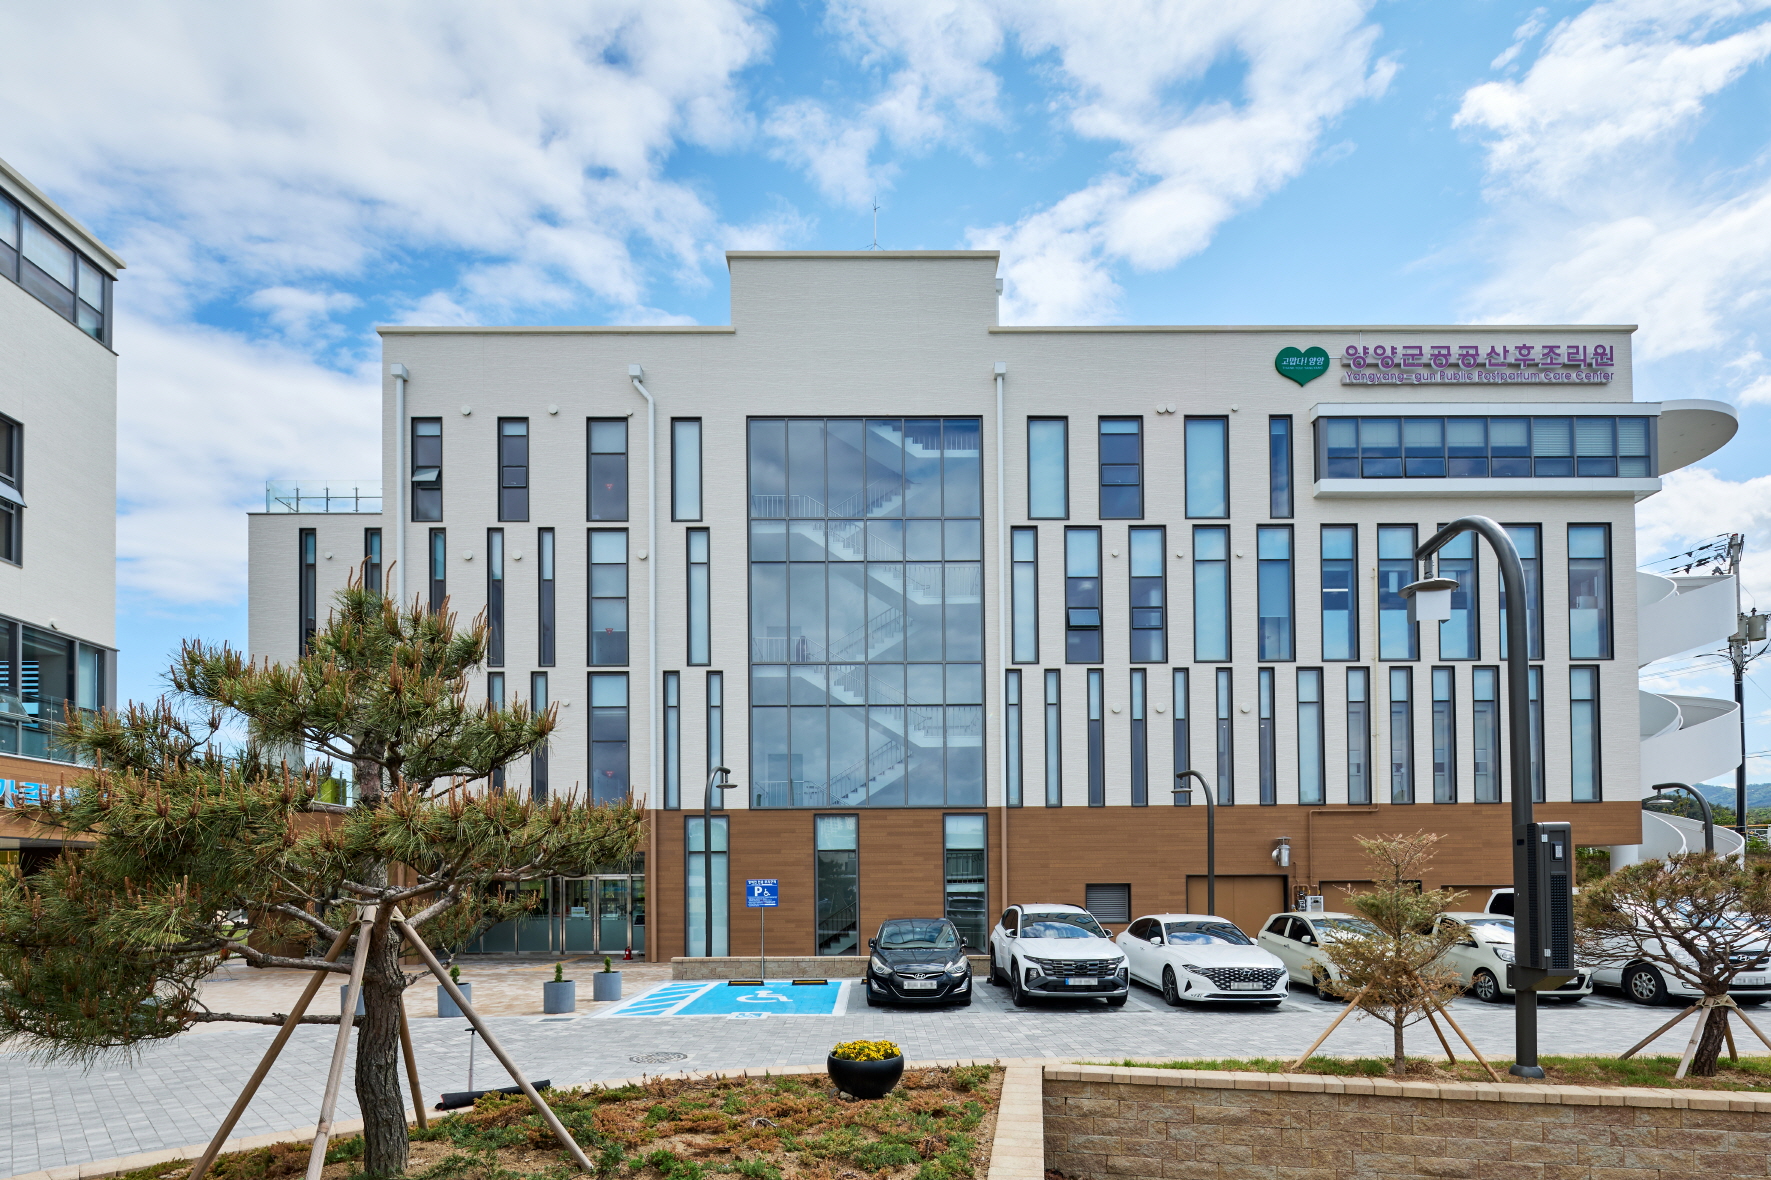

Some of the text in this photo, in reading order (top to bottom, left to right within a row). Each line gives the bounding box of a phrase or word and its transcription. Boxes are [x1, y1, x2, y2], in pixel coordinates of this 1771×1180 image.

[1281, 356, 1325, 366] 고맙다! 양양
[1345, 343, 1615, 369] 양양군공공산후조리원
[1439, 370, 1474, 382] Public
[1477, 370, 1540, 383] Postpartum
[1543, 370, 1572, 382] Care
[1575, 370, 1615, 382] Center
[754, 886, 763, 897] P
